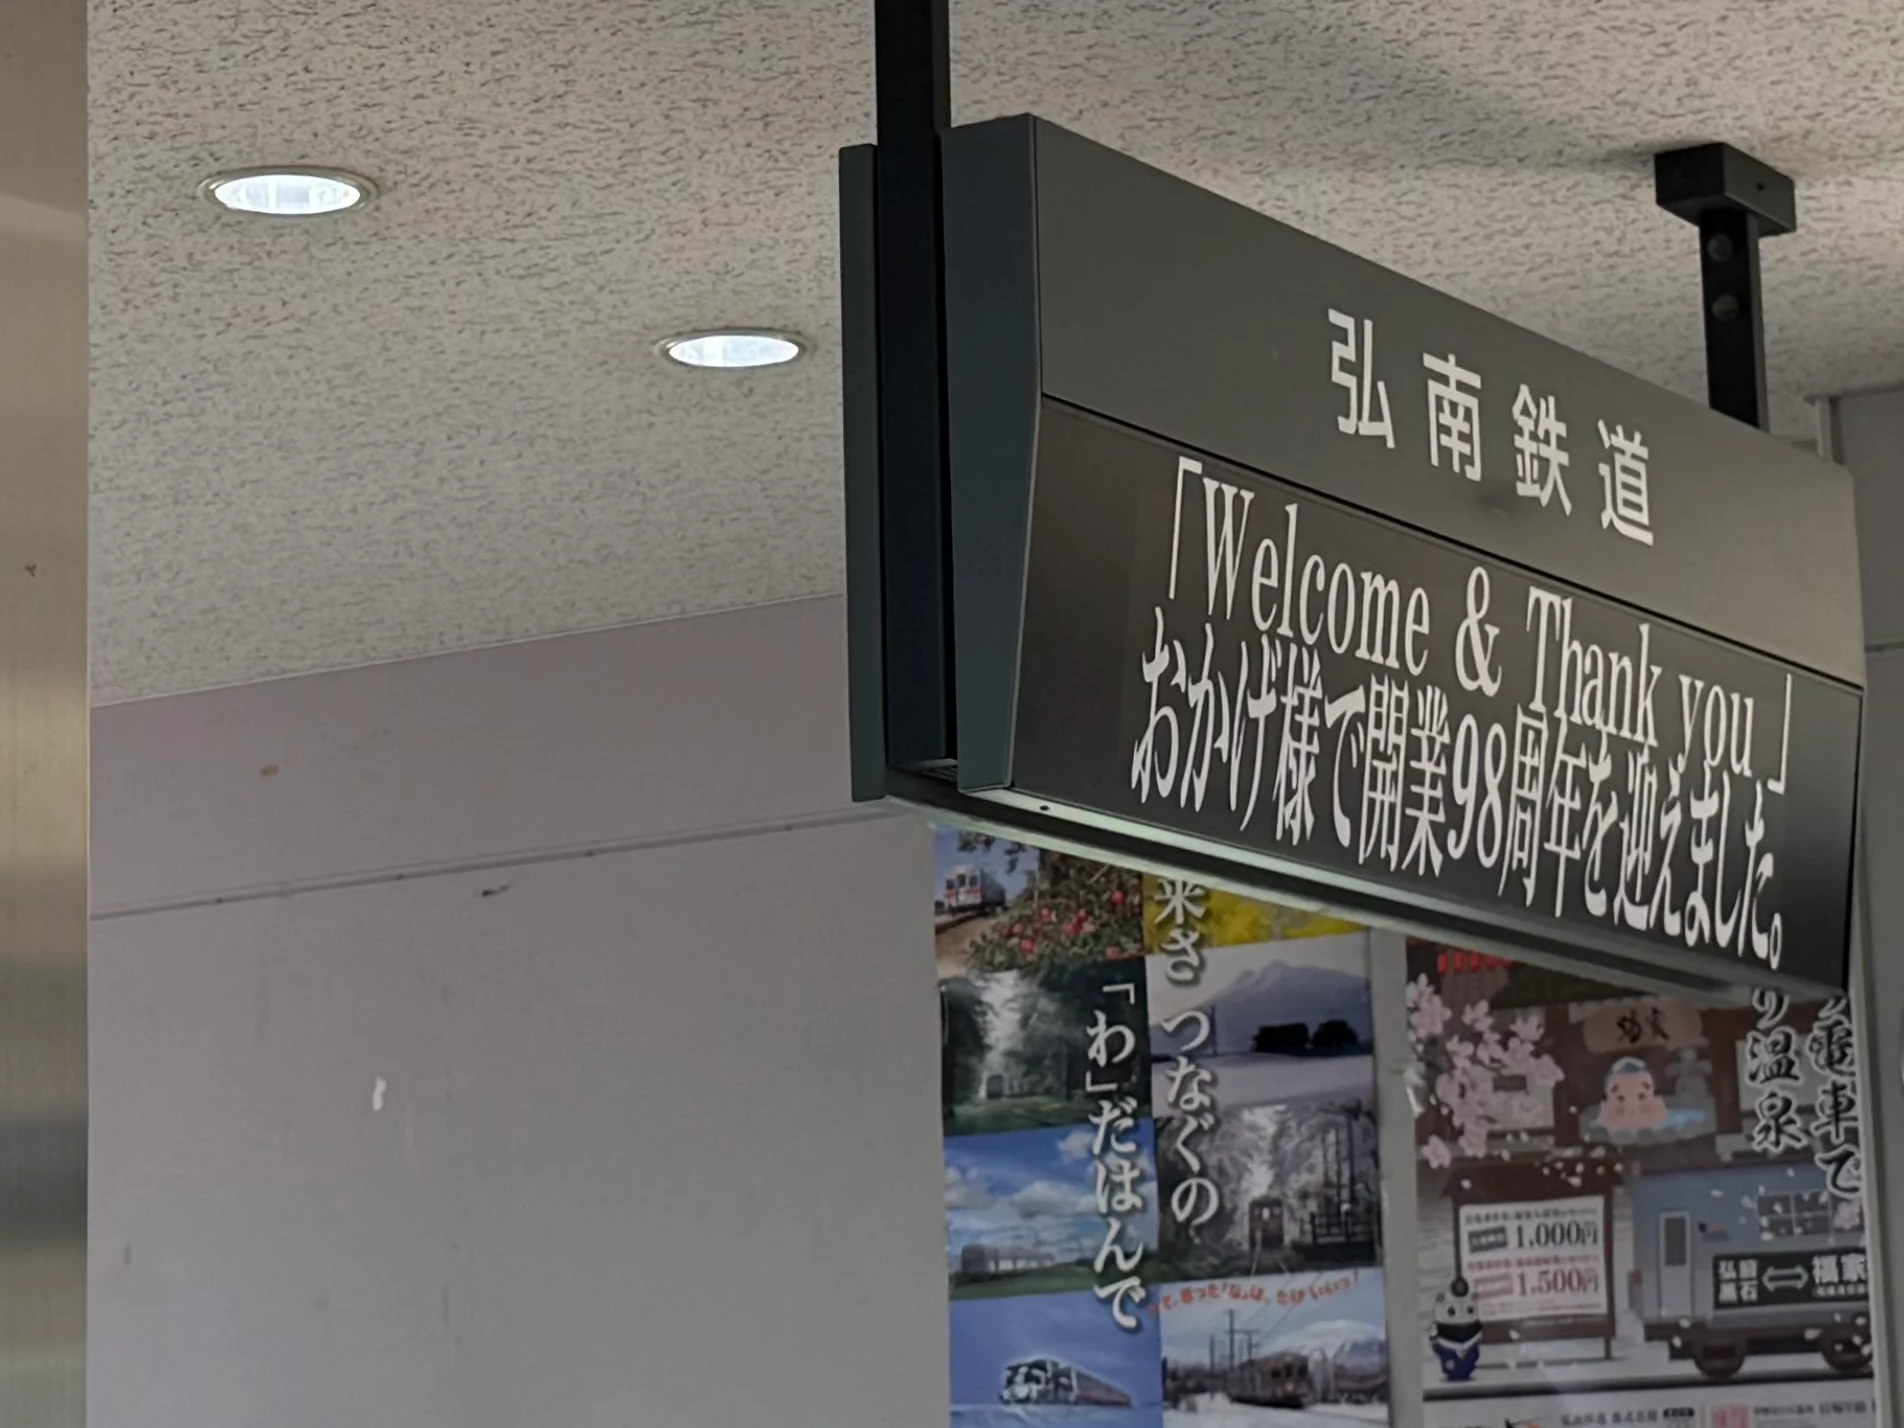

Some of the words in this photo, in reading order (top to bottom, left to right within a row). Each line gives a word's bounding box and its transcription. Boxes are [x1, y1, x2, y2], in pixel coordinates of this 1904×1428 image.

[1329, 308, 1655, 545] 弘南鉄道
[1170, 457, 1430, 675] 「Welcome
[1456, 565, 1501, 696] &
[1526, 587, 1657, 749] Thank
[1132, 607, 1783, 969] おかげ様で開業98周年を迎えました。
[1085, 978, 1148, 1331] 「わ」だはんで
[1159, 1009, 1221, 1228] つなぐの
